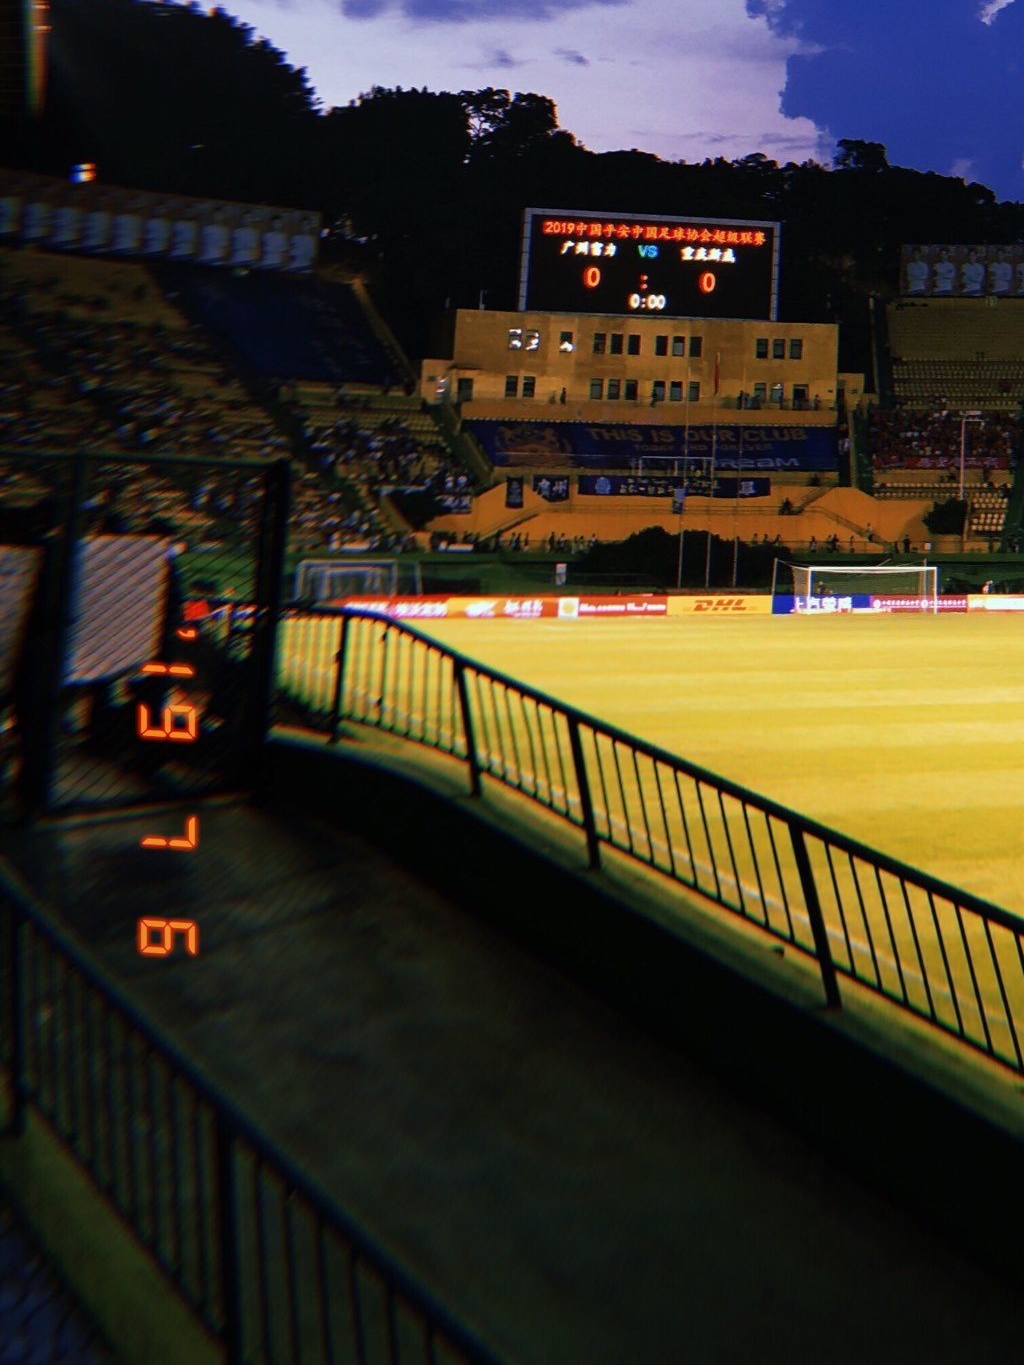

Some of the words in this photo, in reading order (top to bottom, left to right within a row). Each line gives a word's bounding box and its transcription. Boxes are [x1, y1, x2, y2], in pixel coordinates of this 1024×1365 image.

[543, 221, 767, 245] 2019中国平安中国足球协会超级联赛
[560, 241, 617, 257] 广州富力
[637, 244, 659, 259] VS
[585, 266, 601, 288] 0
[700, 272, 716, 293] 0
[628, 293, 667, 310] 0:00
[585, 428, 644, 443] THIS
[651, 429, 676, 443] IS
[743, 428, 809, 442] CLUB
[693, 599, 747, 611] DHL
